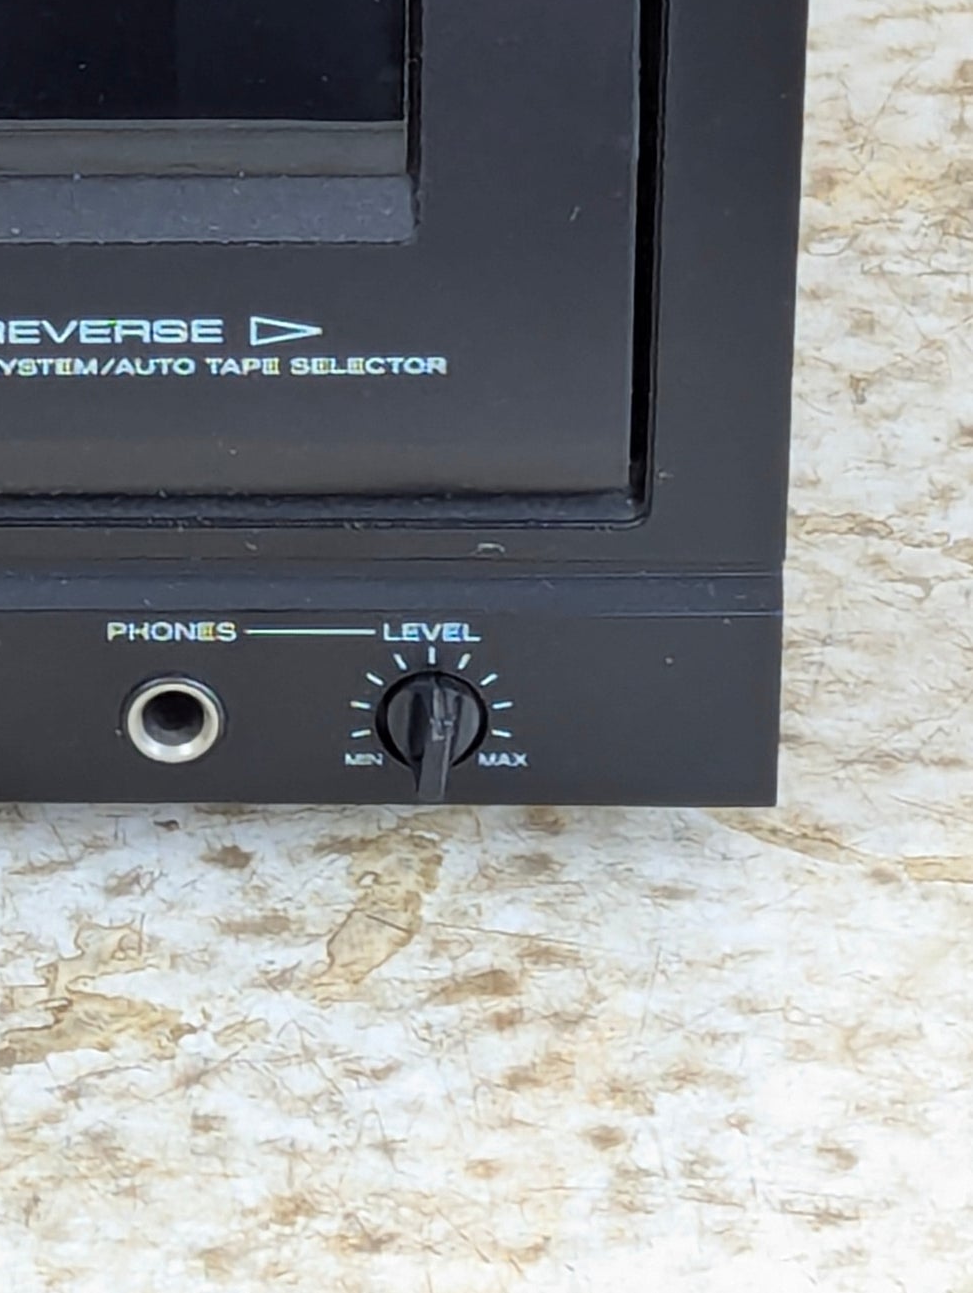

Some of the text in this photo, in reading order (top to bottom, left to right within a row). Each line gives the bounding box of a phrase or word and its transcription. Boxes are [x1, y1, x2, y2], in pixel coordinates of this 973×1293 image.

[205, 357, 280, 376] TAPE
[291, 357, 447, 376] SELECTOR
[107, 621, 482, 642] PHONES LEVEL
[344, 752, 528, 768] MIN MAX
